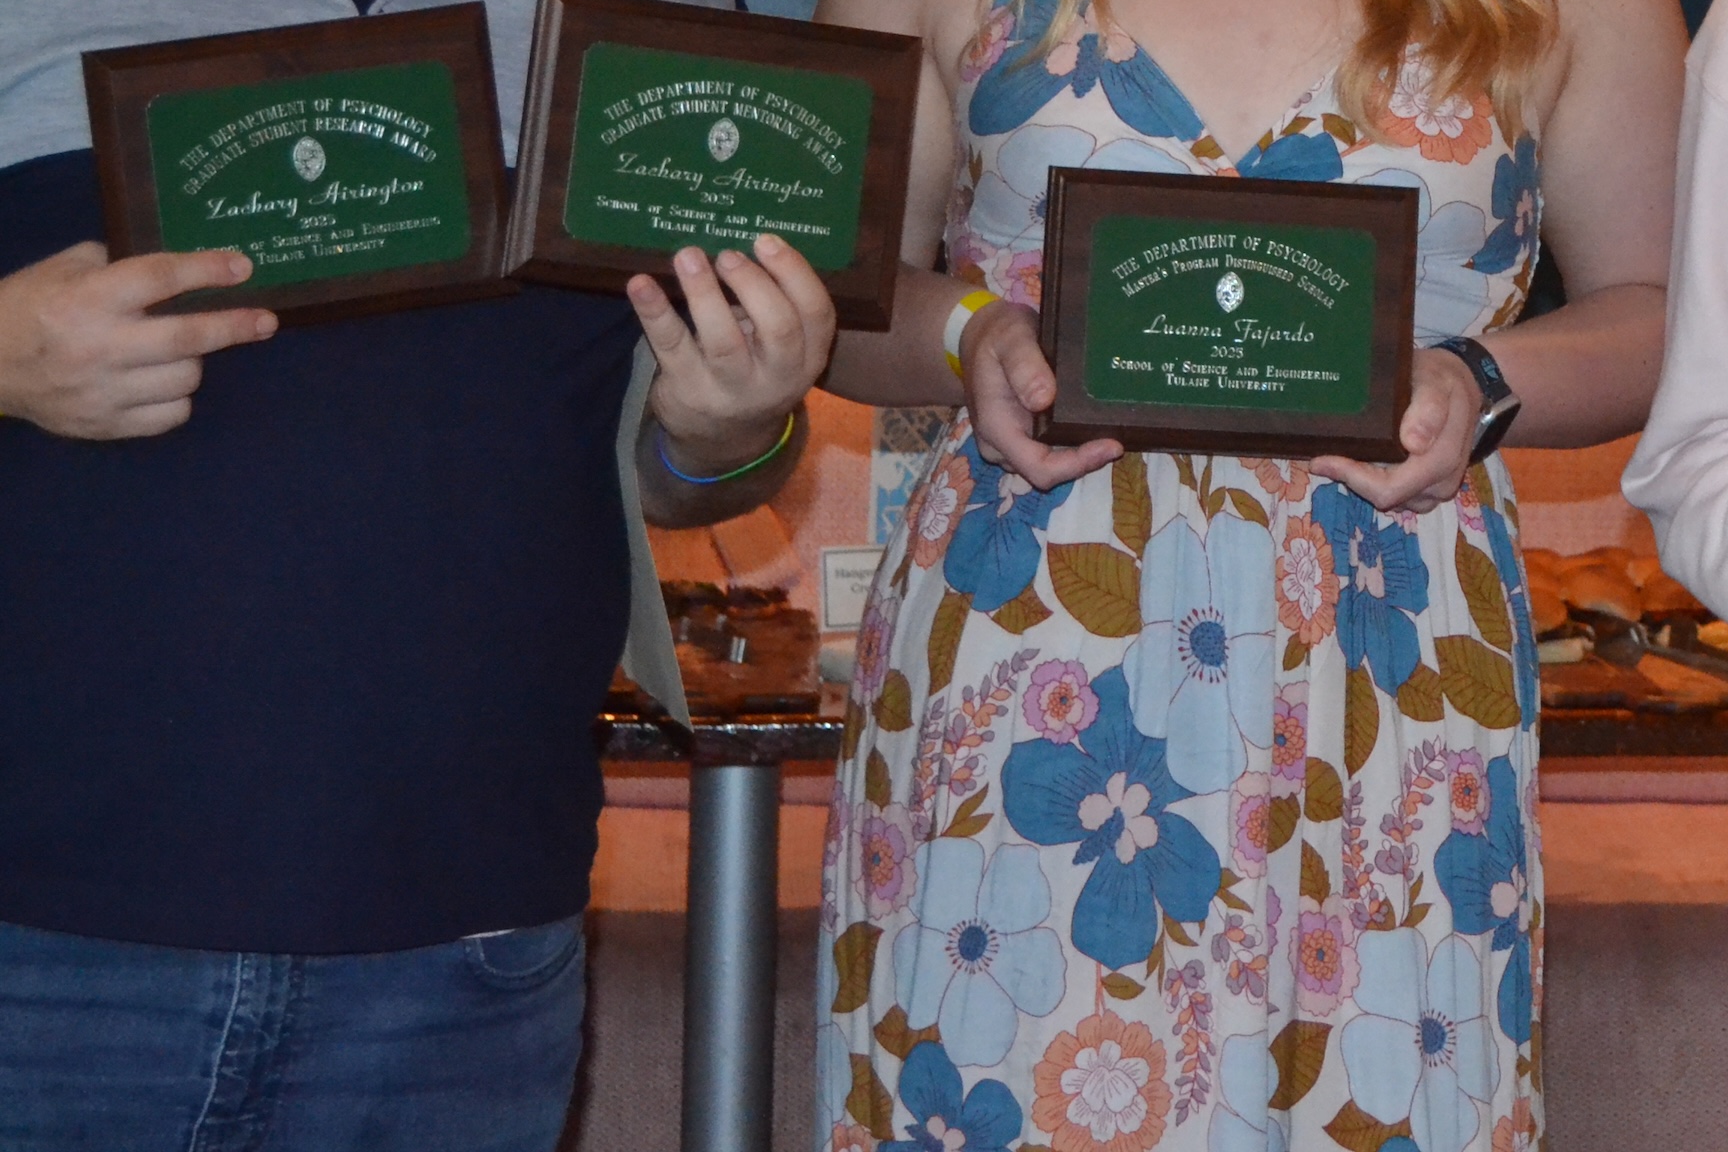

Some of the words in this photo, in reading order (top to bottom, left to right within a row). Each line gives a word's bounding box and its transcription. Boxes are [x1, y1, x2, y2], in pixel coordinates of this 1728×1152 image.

[604, 98, 633, 121] THE
[638, 81, 734, 105] DEPARTMENT
[741, 85, 760, 100] OF
[765, 92, 846, 150] PSYCHOLOGY
[180, 149, 209, 170] THE
[210, 101, 306, 146] DEPARTMENT
[315, 99, 333, 112] OF
[340, 98, 433, 139] PSYCHOLOGY
[601, 108, 667, 146] GRADUATE
[671, 100, 728, 116] STUDENT
[734, 102, 803, 140] MENTORING
[803, 136, 843, 175] AWARD
[183, 141, 246, 196] GRADUATE
[251, 120, 308, 148] STUDENT
[316, 117, 385, 139] RESEARCH
[390, 132, 436, 163] AWARD
[616, 154, 703, 189] Zachary
[205, 192, 298, 220] Zachary
[700, 191, 734, 206] 2025
[299, 216, 336, 229] 2025
[1112, 260, 1140, 280] THE
[1144, 235, 1237, 264] DEPARTMENT
[1243, 237, 1262, 251] OF
[1267, 241, 1349, 293] PSYCHOLOGY
[1143, 314, 1222, 338] Luanna
[1235, 319, 1314, 348] Fajardo
[1210, 346, 1244, 359] 2025
